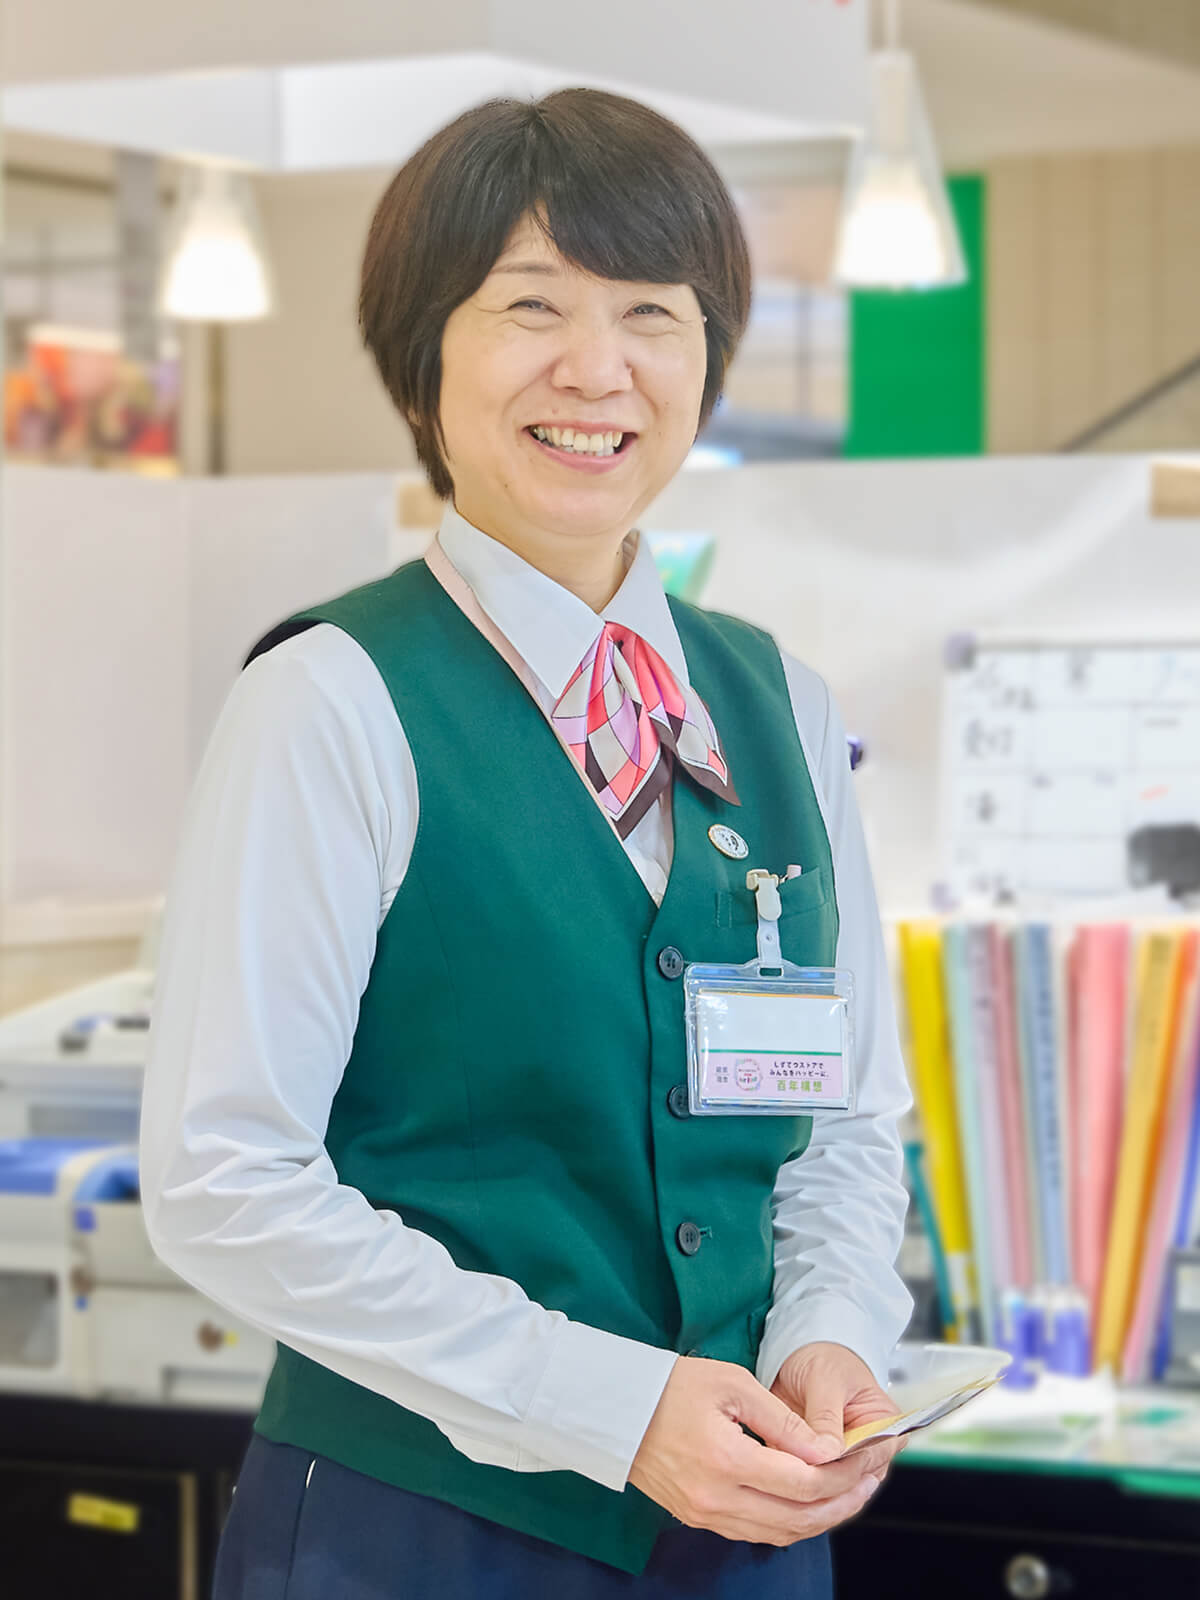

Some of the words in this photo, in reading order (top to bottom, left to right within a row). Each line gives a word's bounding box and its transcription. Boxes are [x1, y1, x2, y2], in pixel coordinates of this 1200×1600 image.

[774, 1061, 824, 1069] しずてつストアで
[776, 1079, 822, 1092] 百年構想
